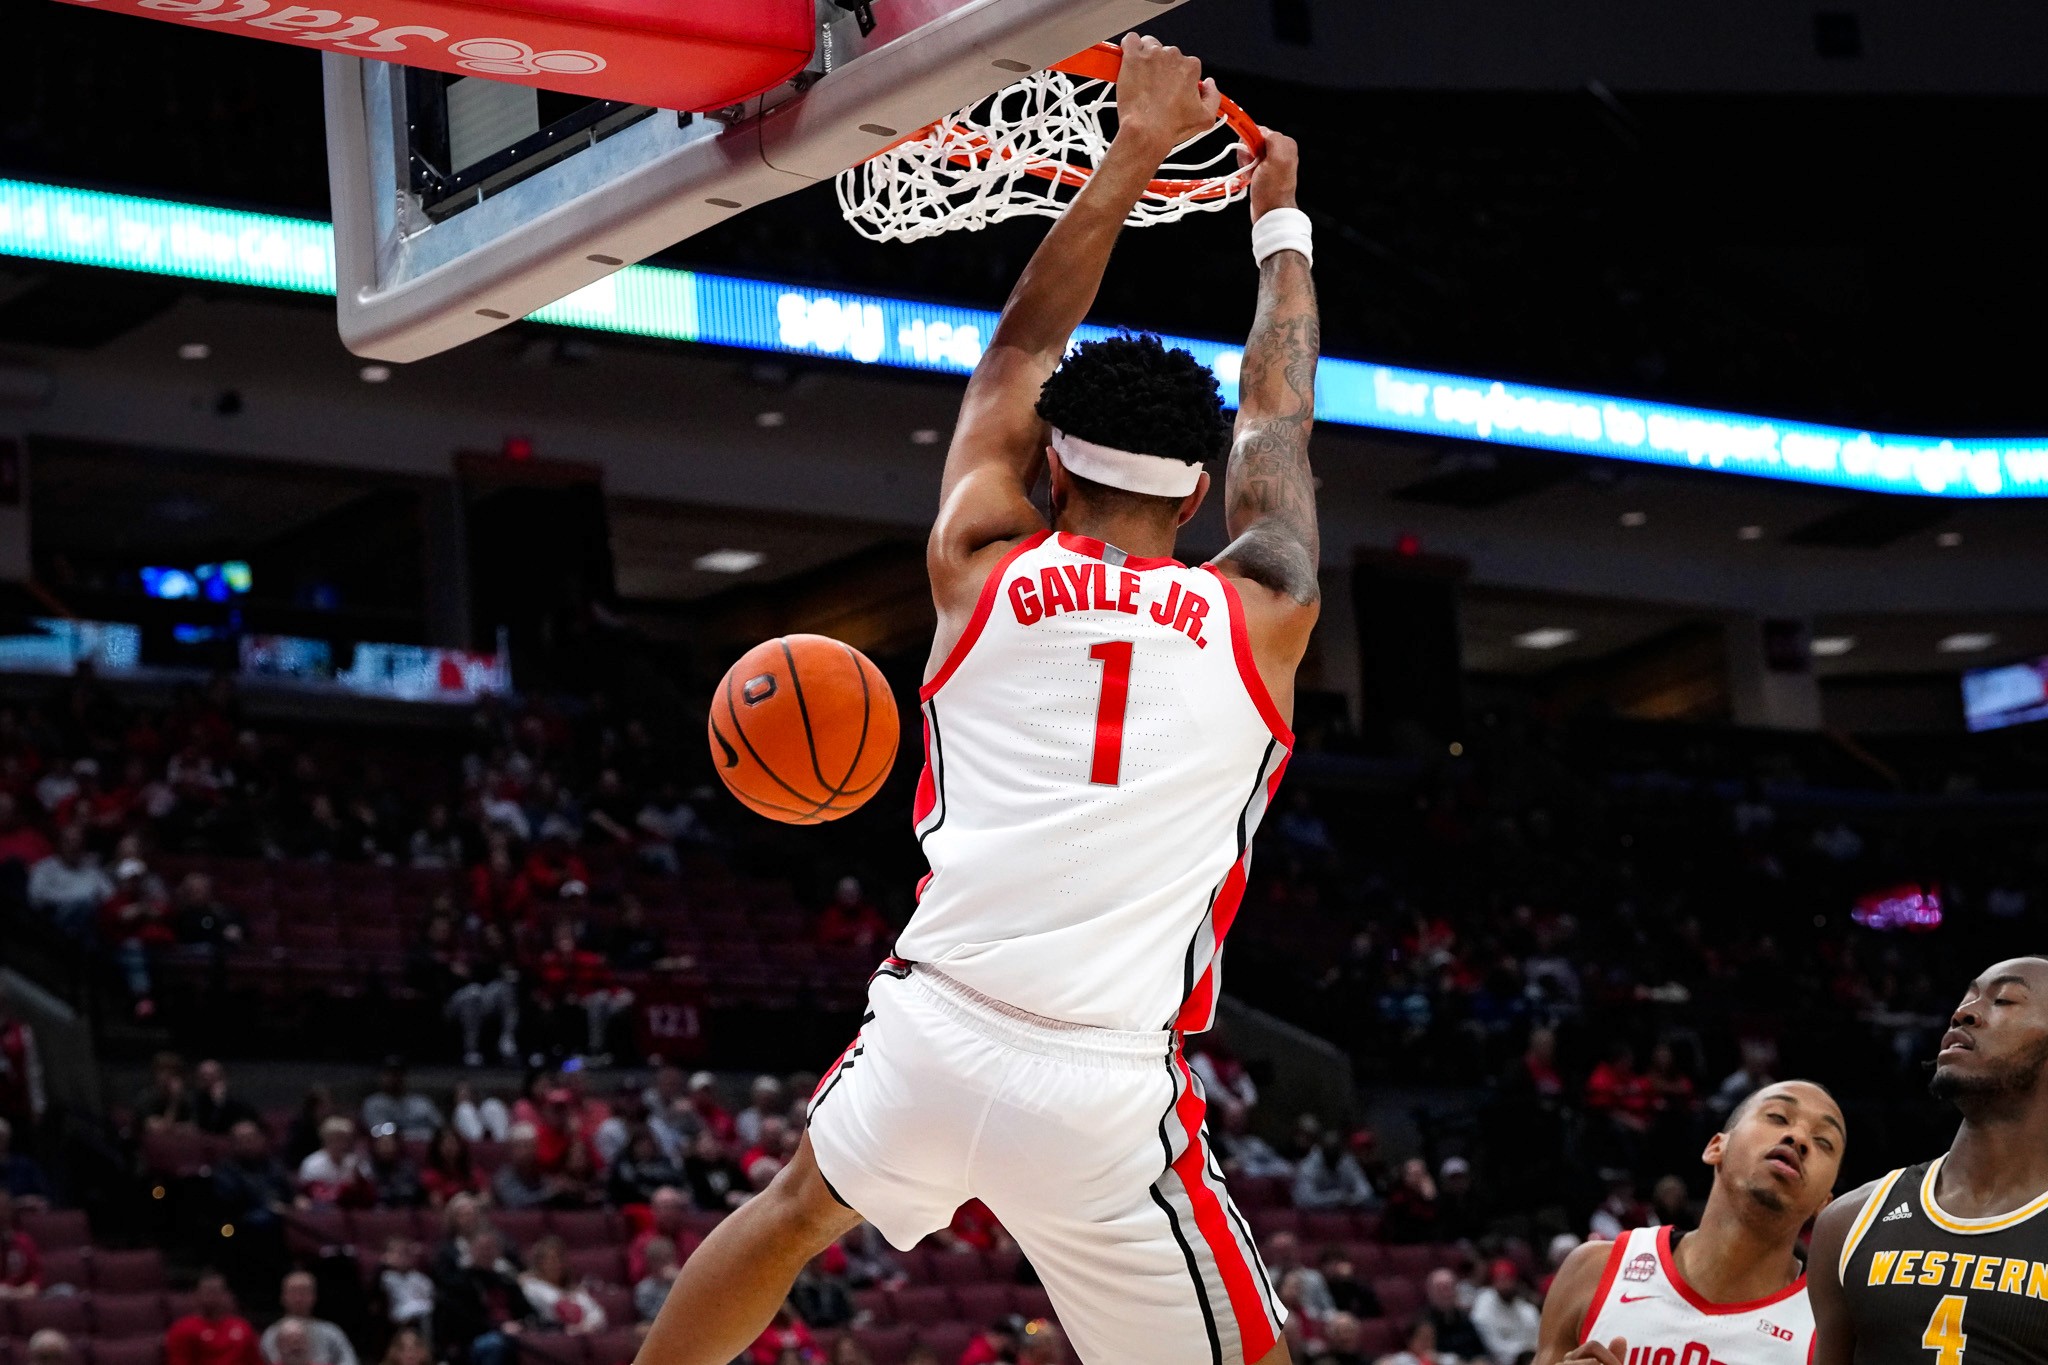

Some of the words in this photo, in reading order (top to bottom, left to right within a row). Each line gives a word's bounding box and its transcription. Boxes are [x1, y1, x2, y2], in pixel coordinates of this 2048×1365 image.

[1008, 563, 1141, 627] GAYLE
[1149, 580, 1211, 650] JR.
[1088, 640, 1136, 787] 1
[1882, 1211, 1913, 1223] adidas
[1867, 1250, 2048, 1302] WESTERN
[1922, 1294, 1968, 1365] 4
